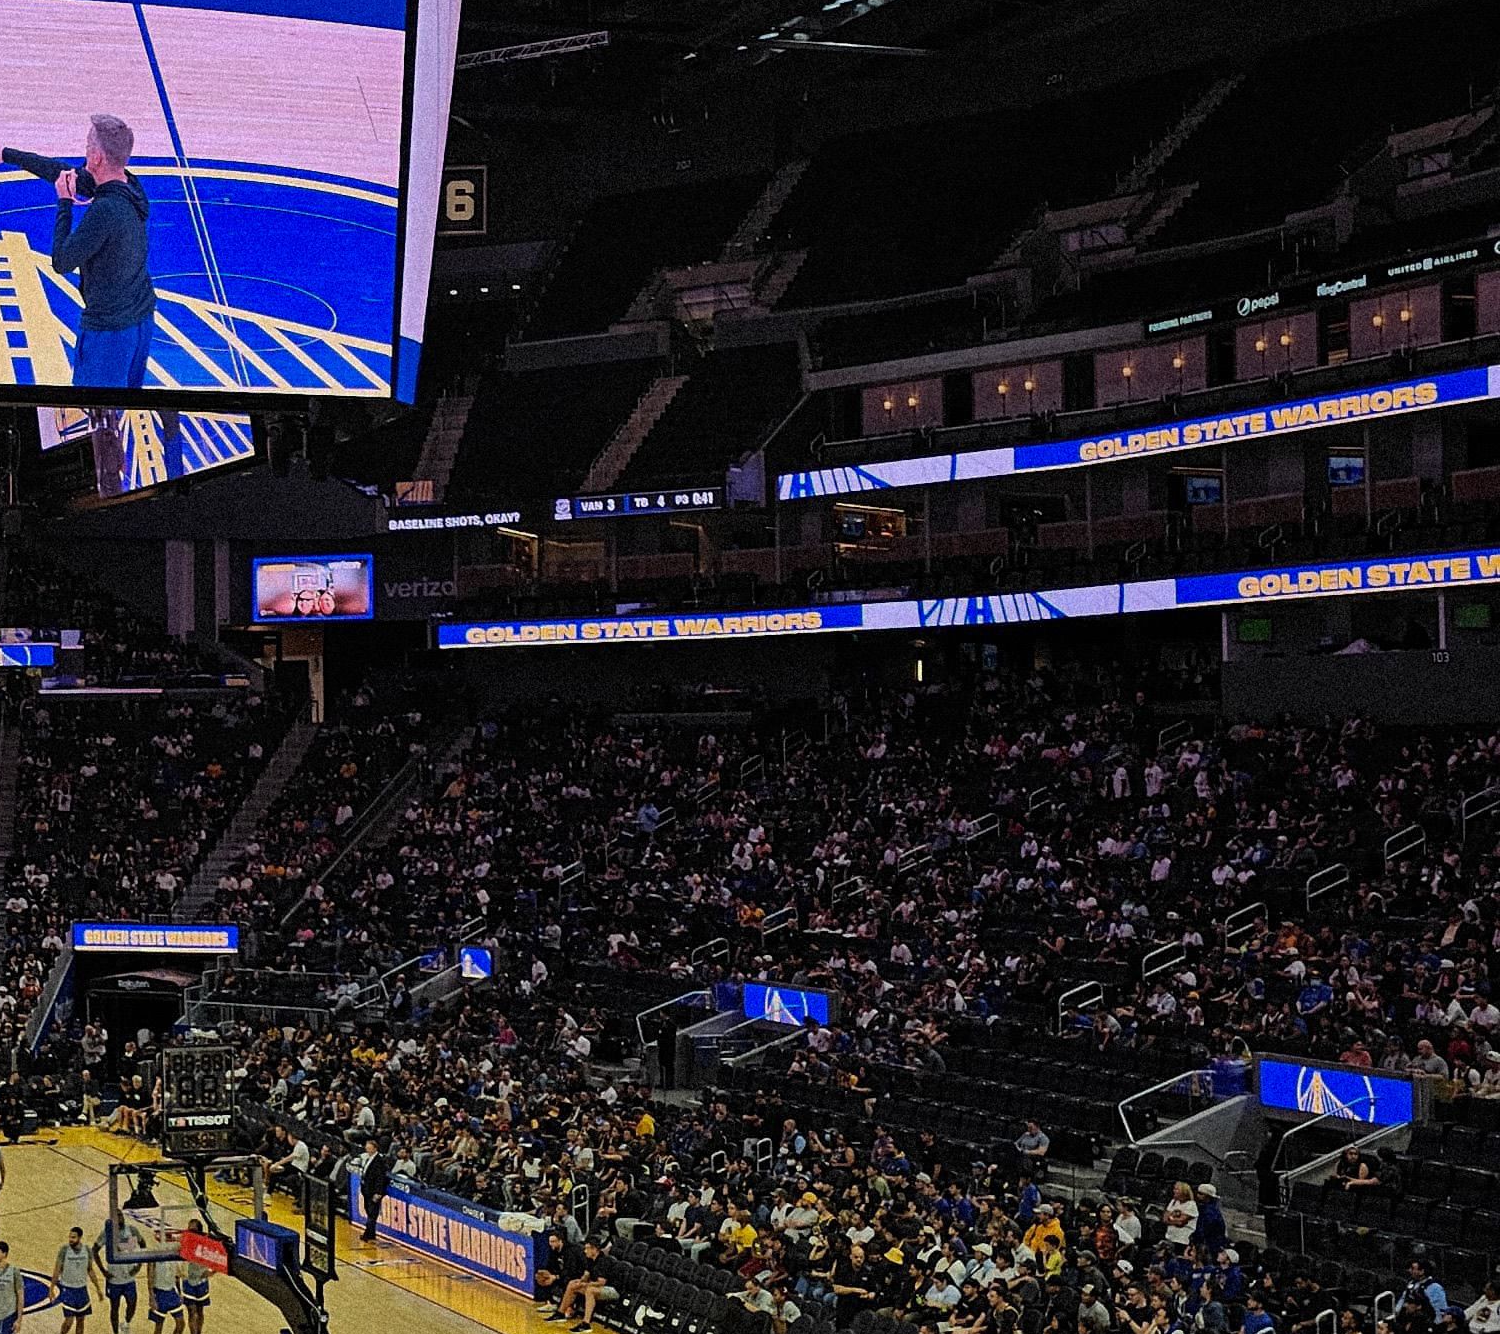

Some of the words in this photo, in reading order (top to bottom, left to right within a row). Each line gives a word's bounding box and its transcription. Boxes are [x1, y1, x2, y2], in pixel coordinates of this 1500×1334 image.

[446, 179, 476, 222] 6
[1388, 262, 1422, 276] UNITED
[1251, 292, 1280, 313] pepsi
[1080, 428, 1179, 461] GOLDEN
[1183, 413, 1266, 444] STATE
[1272, 383, 1438, 430] WARRIORS
[581, 501, 603, 512] VAN
[607, 499, 615, 511] 3
[657, 495, 665, 508] 4
[675, 494, 689, 506] P3
[388, 517, 444, 530] BASELINE
[445, 515, 484, 528] SHOTS,
[485, 512, 520, 525] OKAY?
[1238, 567, 1362, 597] GOLDEN
[1367, 557, 1471, 586] STATE
[466, 624, 577, 644] GOLDEN
[581, 620, 670, 640] STATE
[675, 612, 822, 636] WARRIORS
[1432, 652, 1450, 663] 103
[84, 930, 129, 945] GOLDEN
[130, 930, 165, 946] STATE
[165, 931, 229, 946] WARRIORS
[188, 1114, 231, 1126] TISSOT
[408, 1203, 448, 1250] STATE
[448, 1217, 527, 1282] WARRIORS
